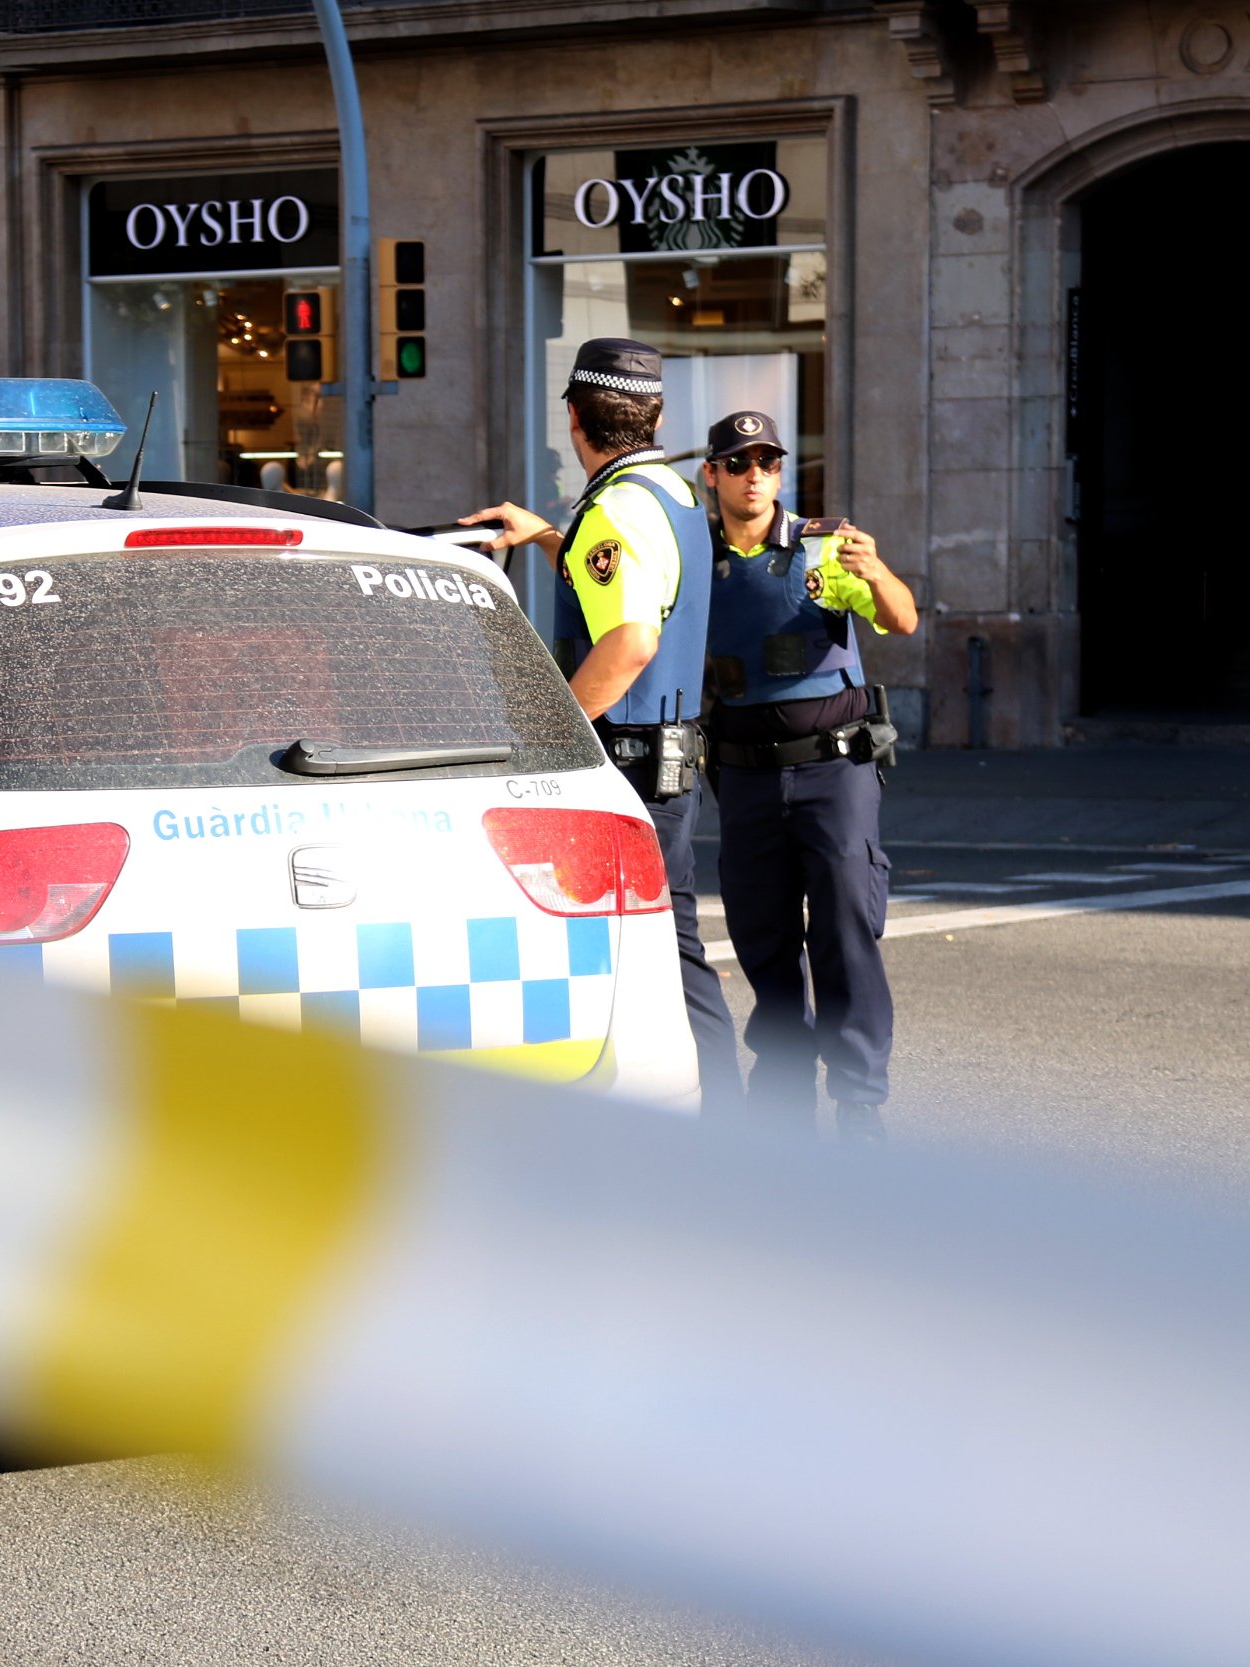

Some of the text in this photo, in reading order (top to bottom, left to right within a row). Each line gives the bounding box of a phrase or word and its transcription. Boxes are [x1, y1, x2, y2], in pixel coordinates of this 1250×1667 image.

[574, 169, 786, 228] OYSHO
[126, 196, 309, 249] OYSHO
[351, 565, 496, 610] Policia
[506, 780, 561, 799] C-709
[152, 804, 306, 841] Guàrdia
